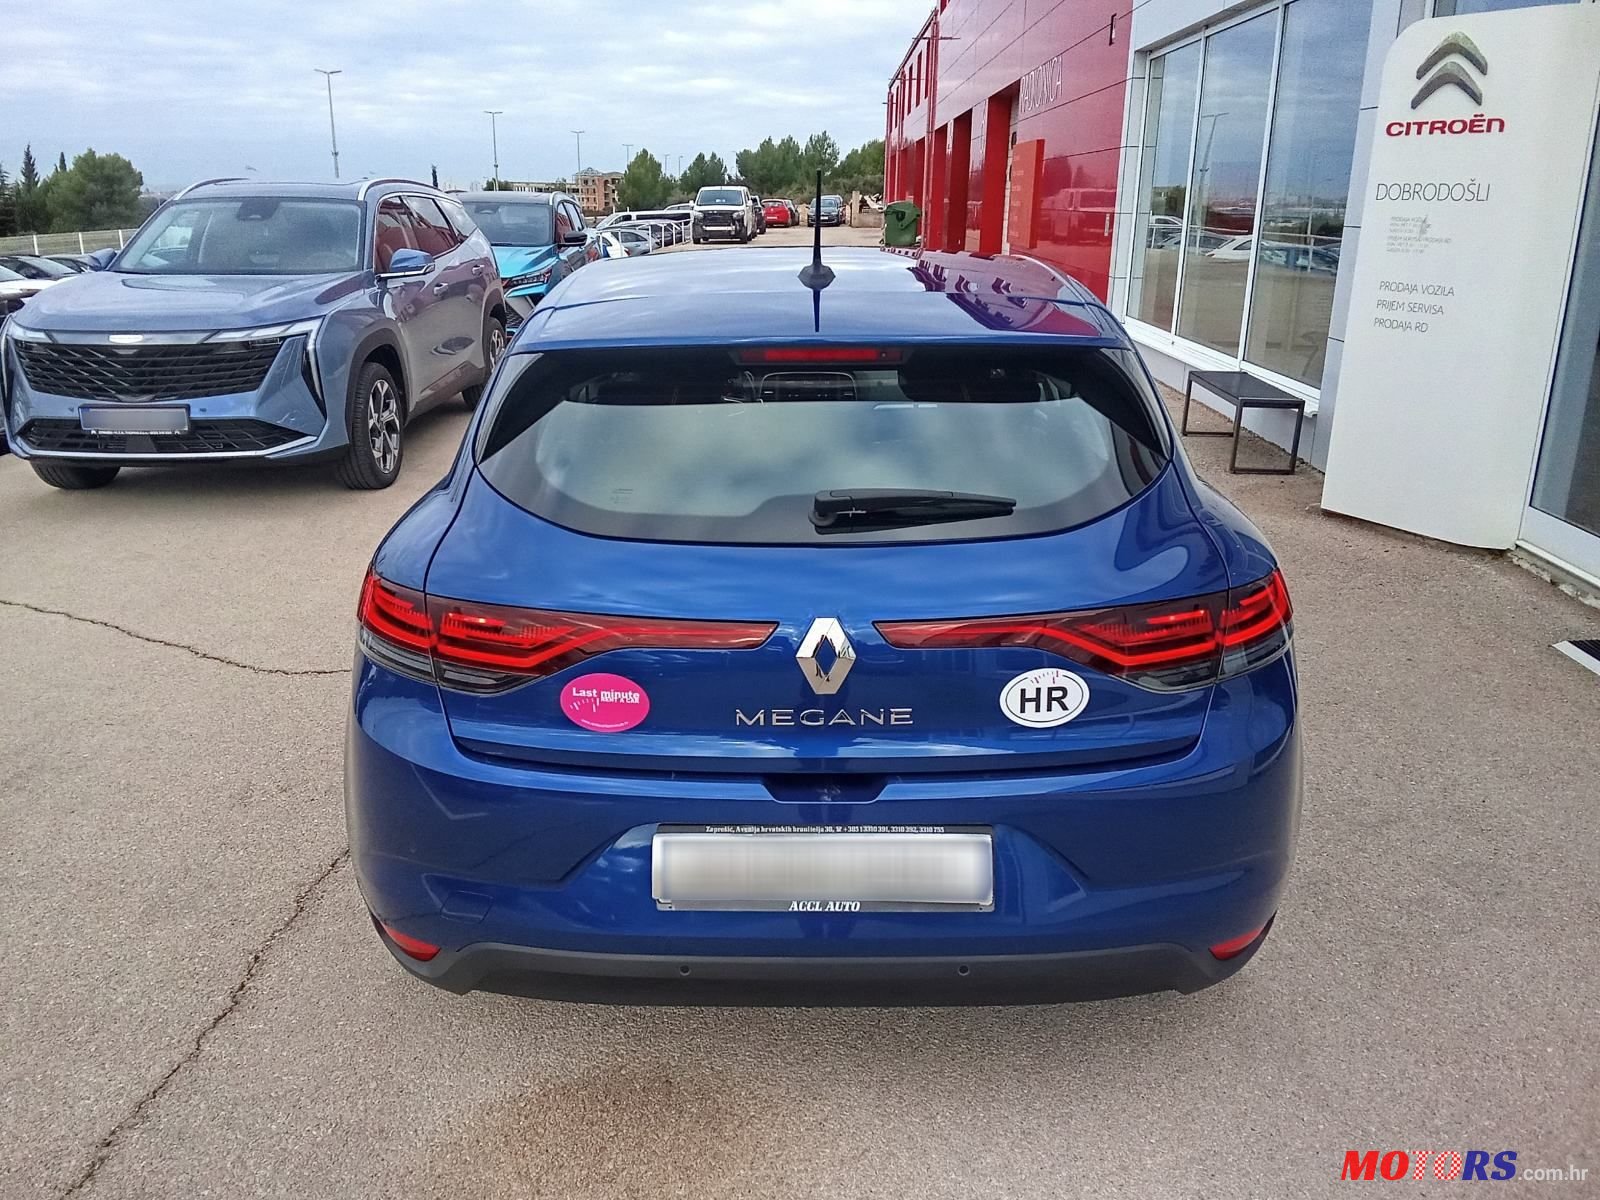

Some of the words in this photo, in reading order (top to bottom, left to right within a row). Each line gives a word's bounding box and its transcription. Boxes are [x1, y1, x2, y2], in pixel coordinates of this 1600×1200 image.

[1375, 178, 1491, 202] DOBRODOŠLI
[1379, 280, 1419, 295] PRODAJA
[1421, 284, 1455, 297] VOZILA
[1376, 299, 1406, 312] PRIJEM
[1407, 302, 1444, 315] SERVISA
[1373, 317, 1413, 332] PRODAJA
[1415, 321, 1429, 333] RD
[572, 687, 598, 698] Last
[600, 689, 640, 700] minute
[1019, 685, 1069, 714] HR
[735, 708, 914, 727] MEGANE
[824, 900, 861, 912] AUTO
